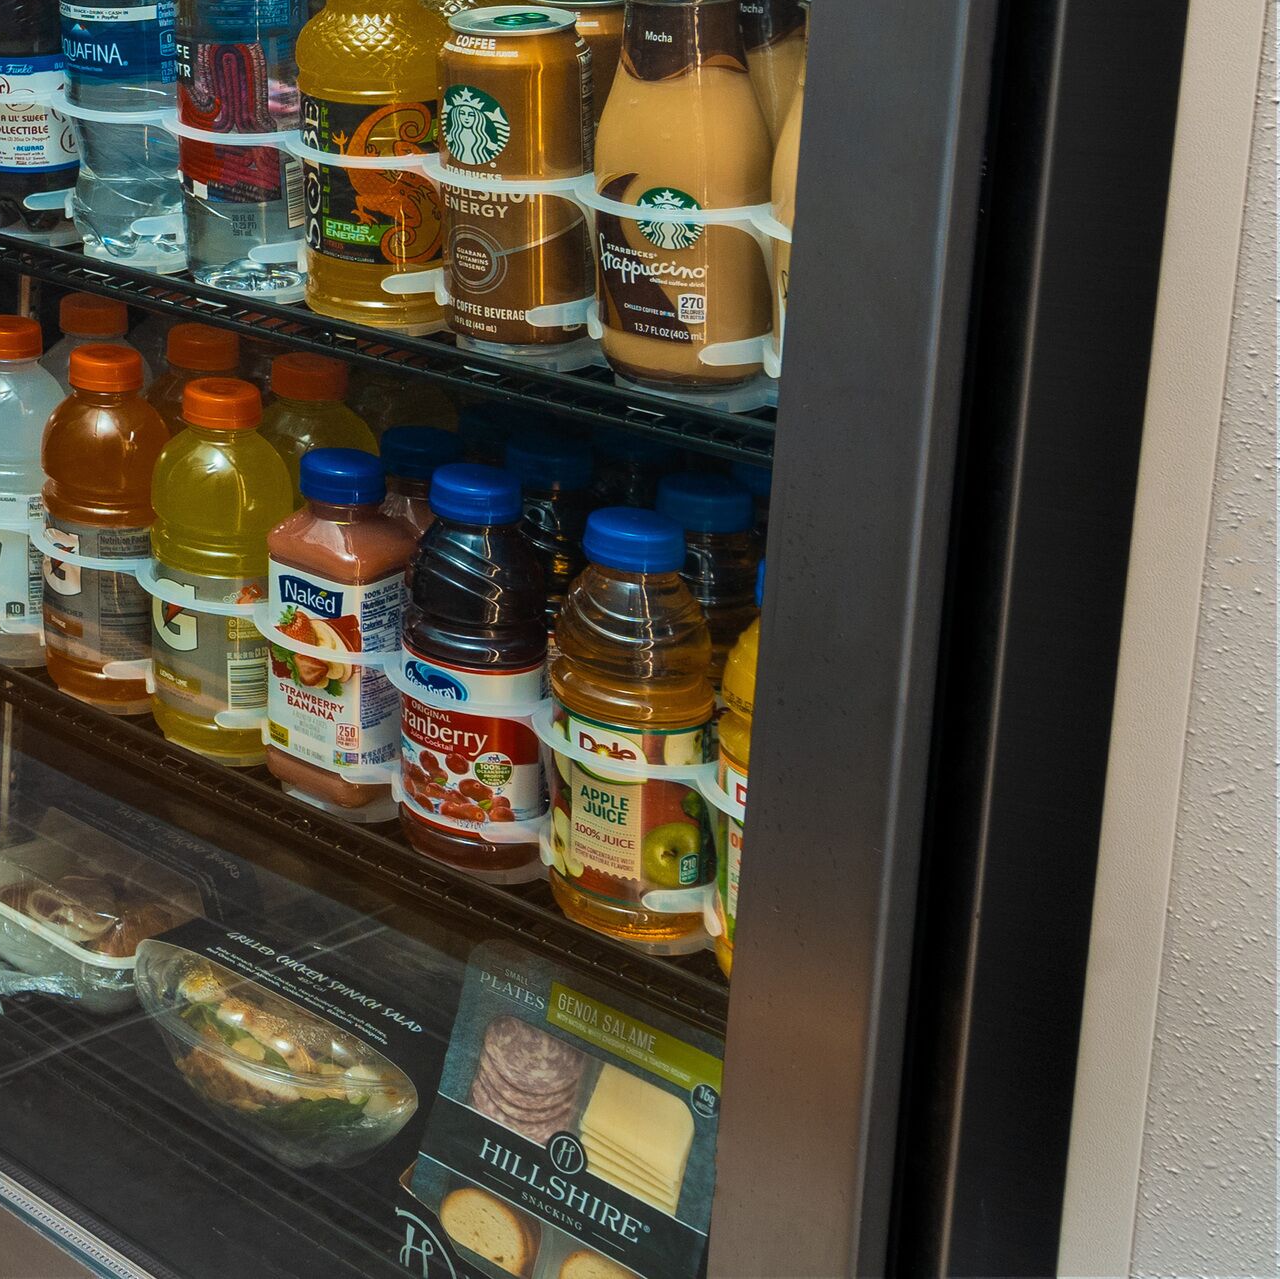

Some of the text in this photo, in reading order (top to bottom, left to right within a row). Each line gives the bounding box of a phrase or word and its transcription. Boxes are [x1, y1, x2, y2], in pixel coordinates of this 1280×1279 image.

[456, 34, 497, 50] COFFEE
[644, 31, 673, 44] Mocha
[444, 197, 509, 219] ENERGY
[325, 220, 371, 235] CITRUS
[599, 232, 706, 284] frappuccino
[606, 243, 654, 260] STARBUCKS
[681, 296, 704, 310] 270
[9, 603, 21, 615] 10
[284, 579, 337, 615] Naked
[279, 681, 345, 715] STRAWBERRY
[286, 695, 336, 723] BANANA
[411, 700, 452, 724] ORIGINAL
[338, 724, 356, 739] 250
[578, 731, 637, 762] Dole
[580, 784, 630, 812] APPLE
[582, 800, 628, 826] JUICE
[574, 822, 636, 851] 100% JUICE
[226, 930, 423, 1034] GRILLED CHICKEN SPINACH SALAD
[479, 970, 546, 1011] PLATES
[504, 968, 529, 986] SMALL
[557, 992, 599, 1026] GENOA
[601, 1014, 658, 1055] SALAME
[698, 1085, 717, 1106] 16g
[478, 1136, 645, 1244] HILLSHIRE
[521, 1191, 584, 1232] SNACKING
